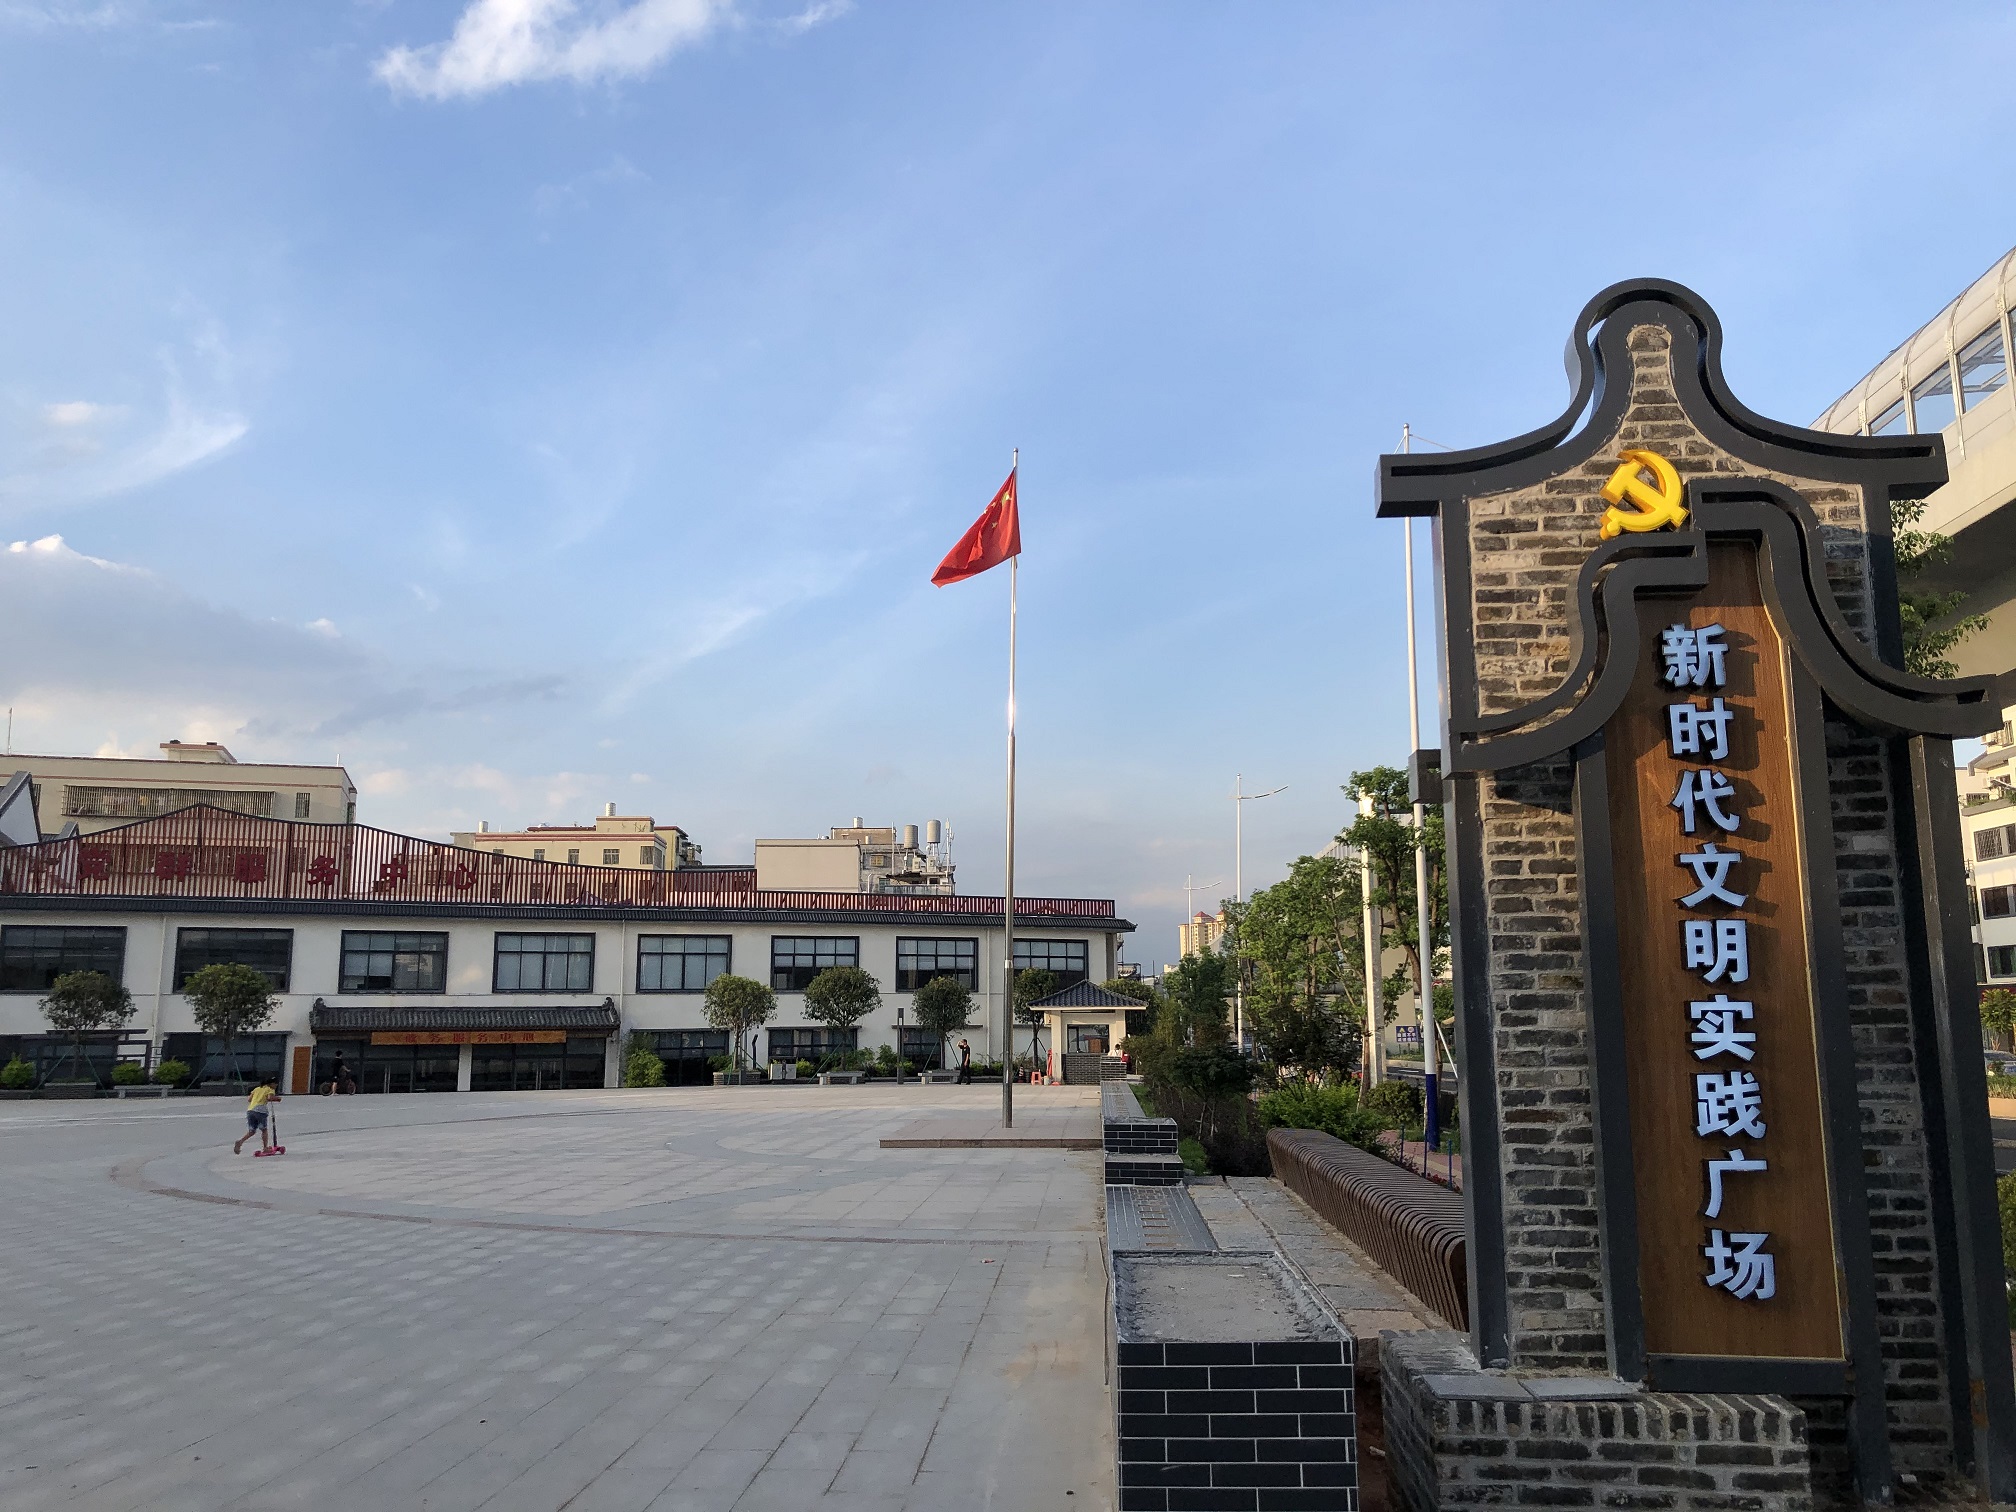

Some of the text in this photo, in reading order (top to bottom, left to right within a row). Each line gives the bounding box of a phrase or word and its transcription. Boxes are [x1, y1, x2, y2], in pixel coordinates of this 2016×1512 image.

[1661, 623, 1777, 1300] 新时代文明实践广场
